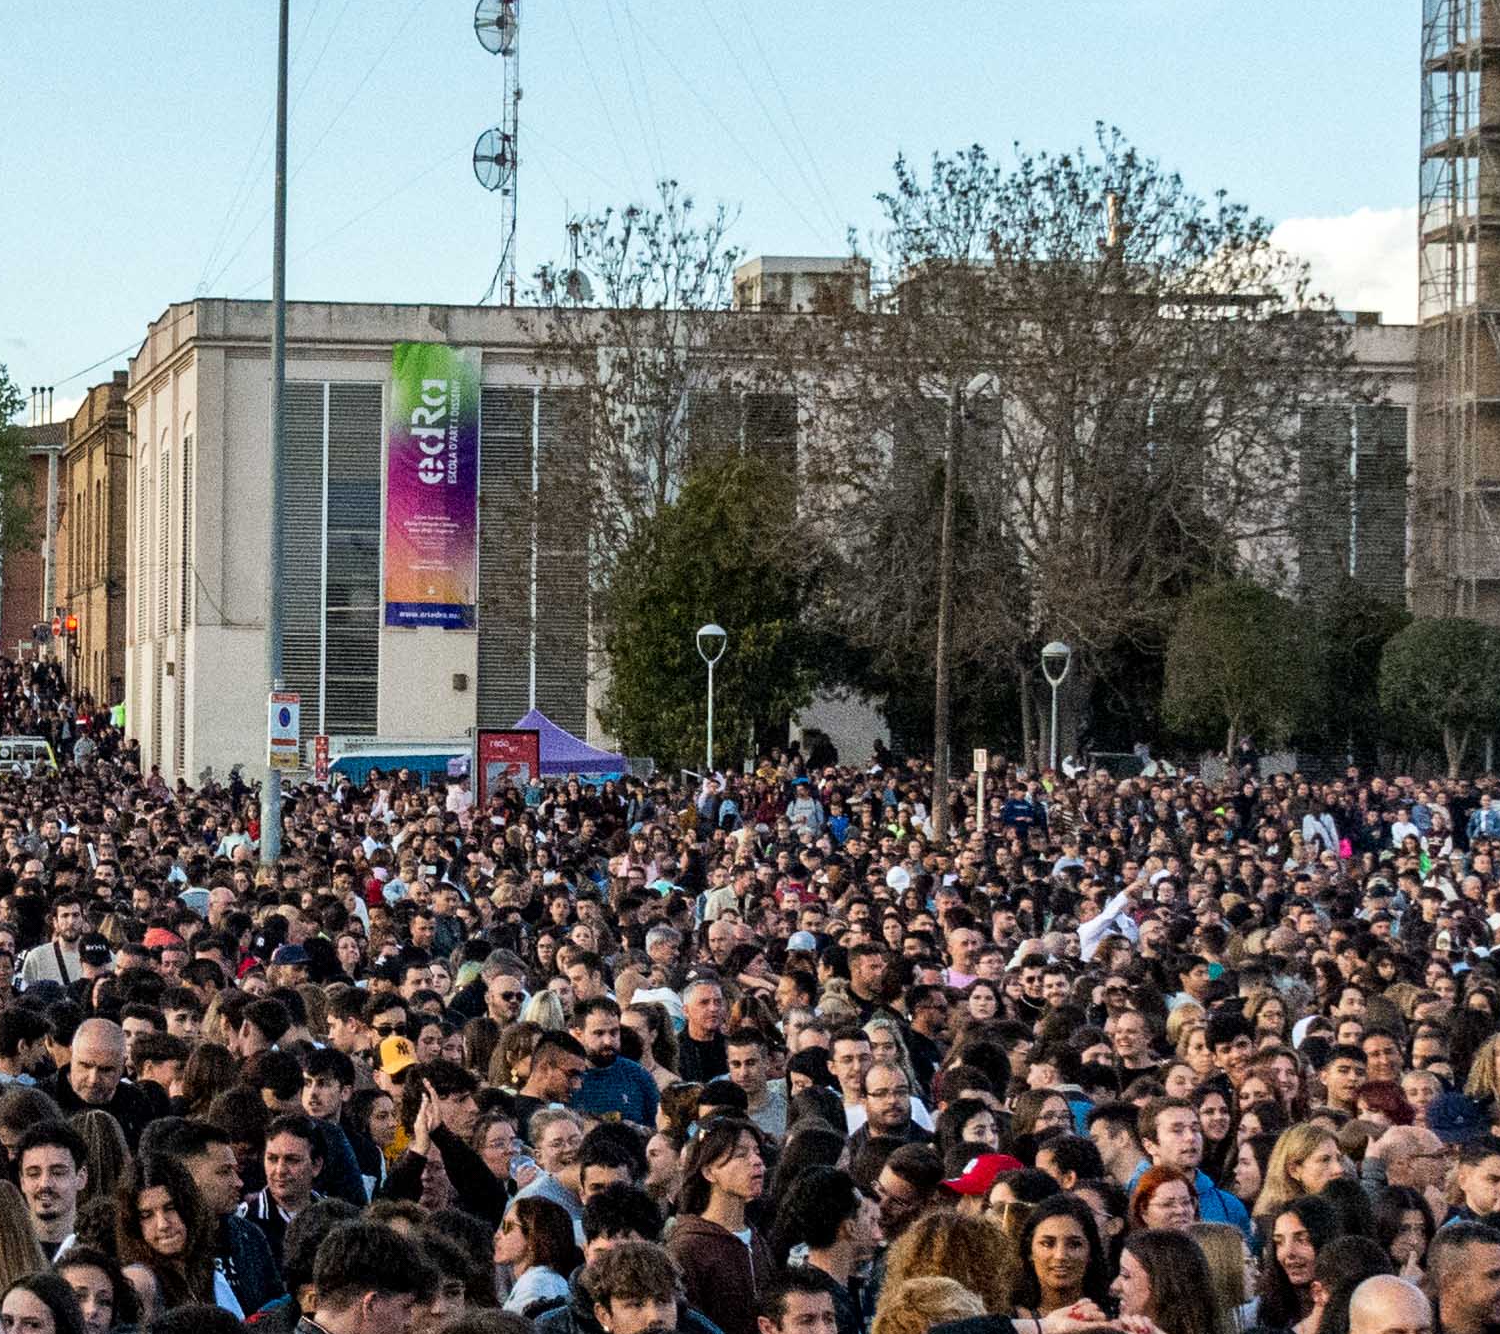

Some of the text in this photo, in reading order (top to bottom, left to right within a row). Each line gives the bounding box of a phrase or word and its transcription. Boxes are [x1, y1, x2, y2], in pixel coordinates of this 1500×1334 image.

[450, 380, 461, 417] DISSENY
[449, 424, 459, 450] D'ART
[448, 452, 458, 484] ESCOLA
